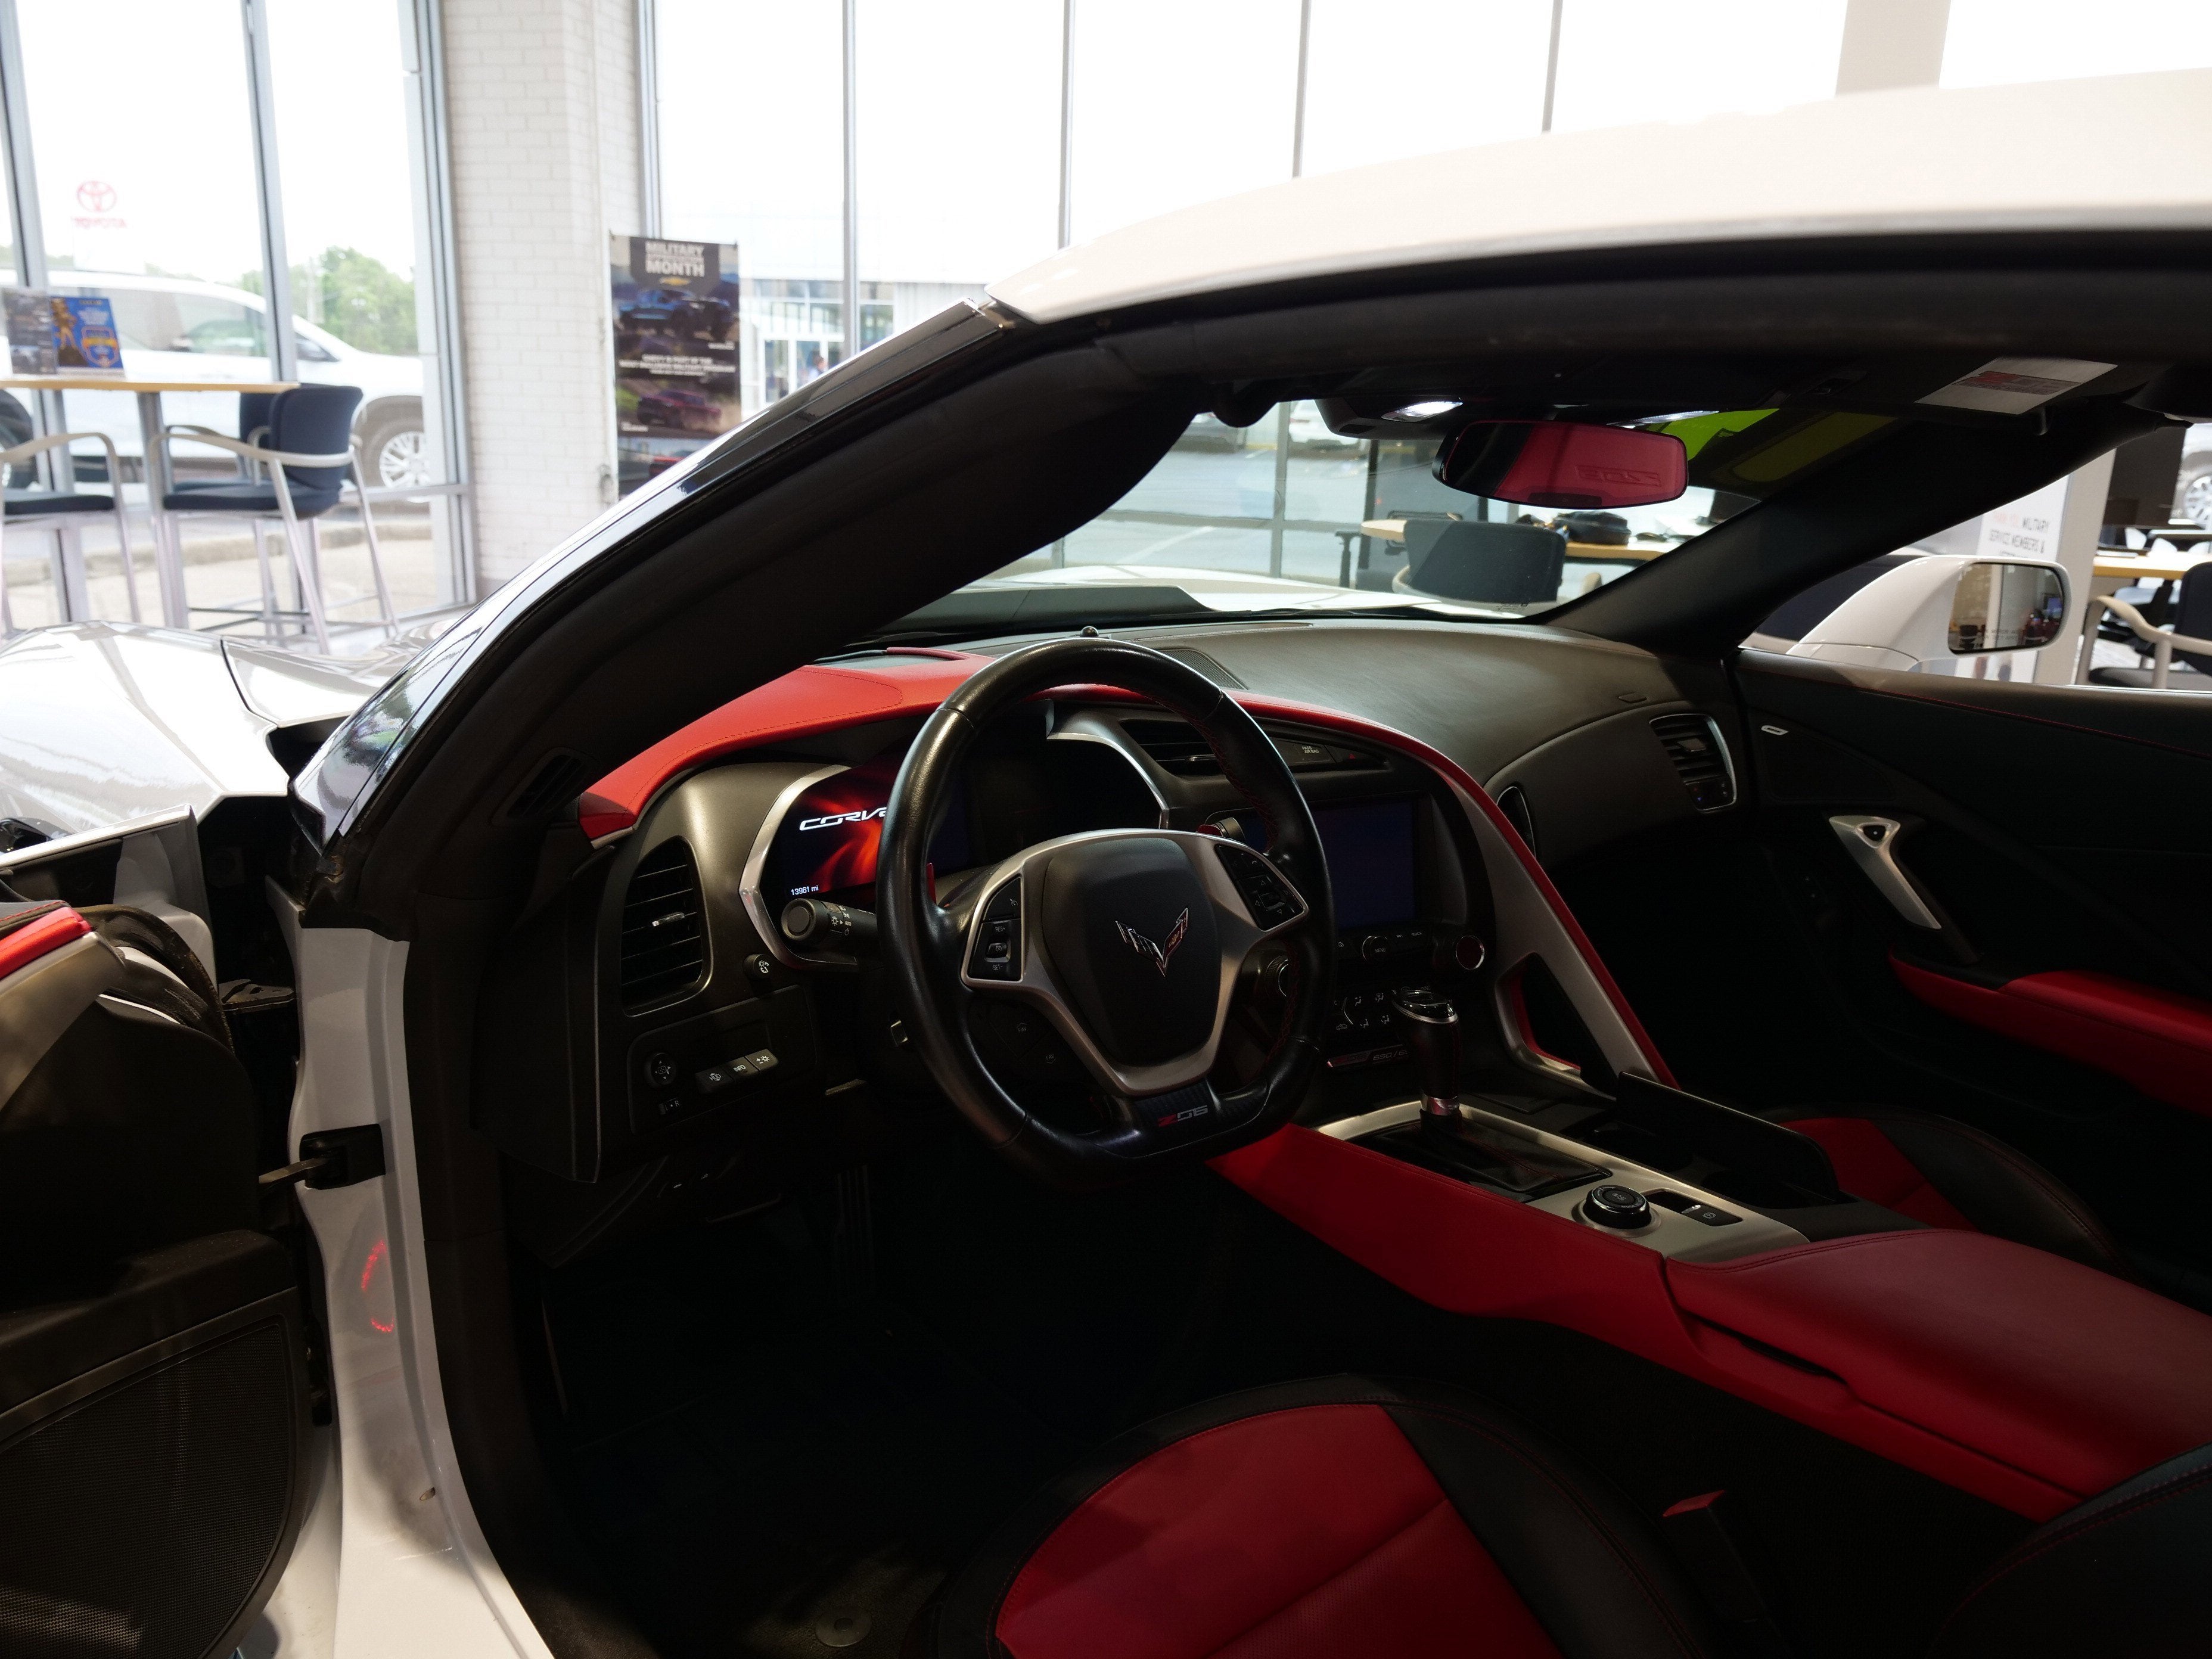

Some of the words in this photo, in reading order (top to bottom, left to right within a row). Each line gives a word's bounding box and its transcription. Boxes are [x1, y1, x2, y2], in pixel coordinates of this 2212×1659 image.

[645, 240, 704, 257] MILITARY
[645, 259, 704, 278] MONTH
[791, 886, 810, 896] 13961
[1372, 1049, 1408, 1061] 650/6
[1158, 1105, 1208, 1127] Z06
